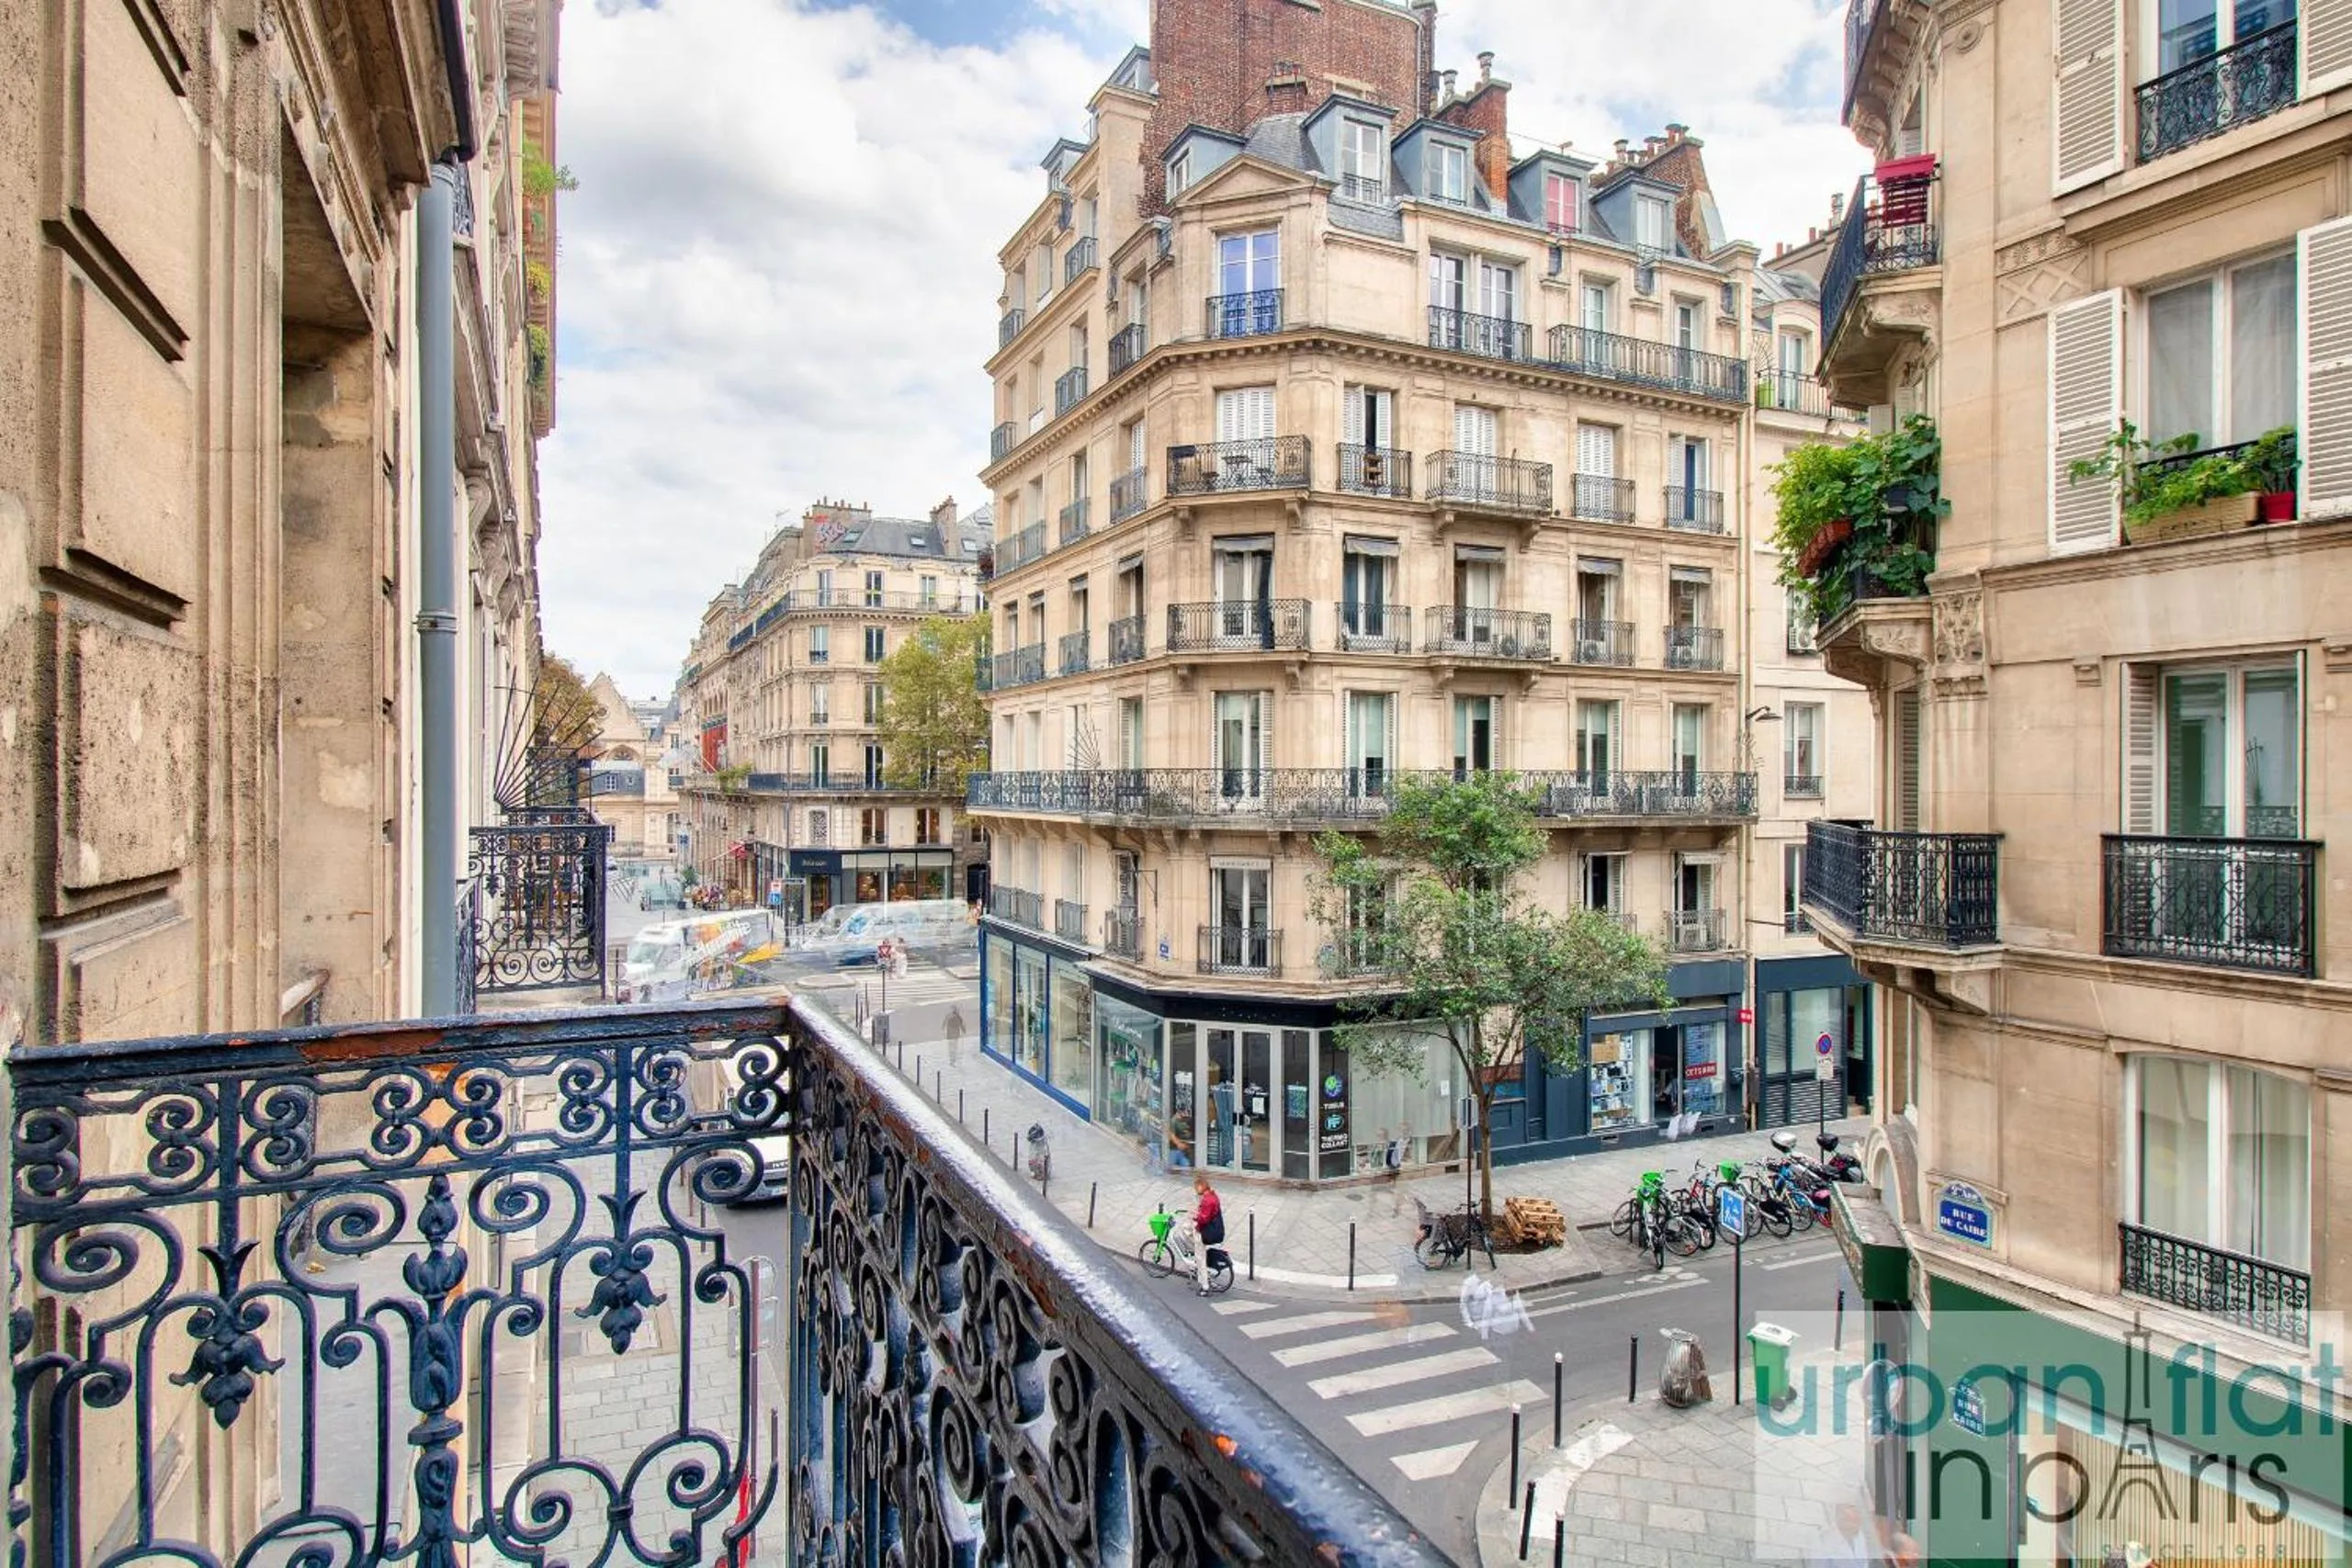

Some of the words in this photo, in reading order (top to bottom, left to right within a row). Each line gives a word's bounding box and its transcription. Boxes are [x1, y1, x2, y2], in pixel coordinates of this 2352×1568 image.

[1952, 1208, 1975, 1223] RUE
[1940, 1215, 1952, 1227] DU
[1956, 1221, 1986, 1236] CAIRE
